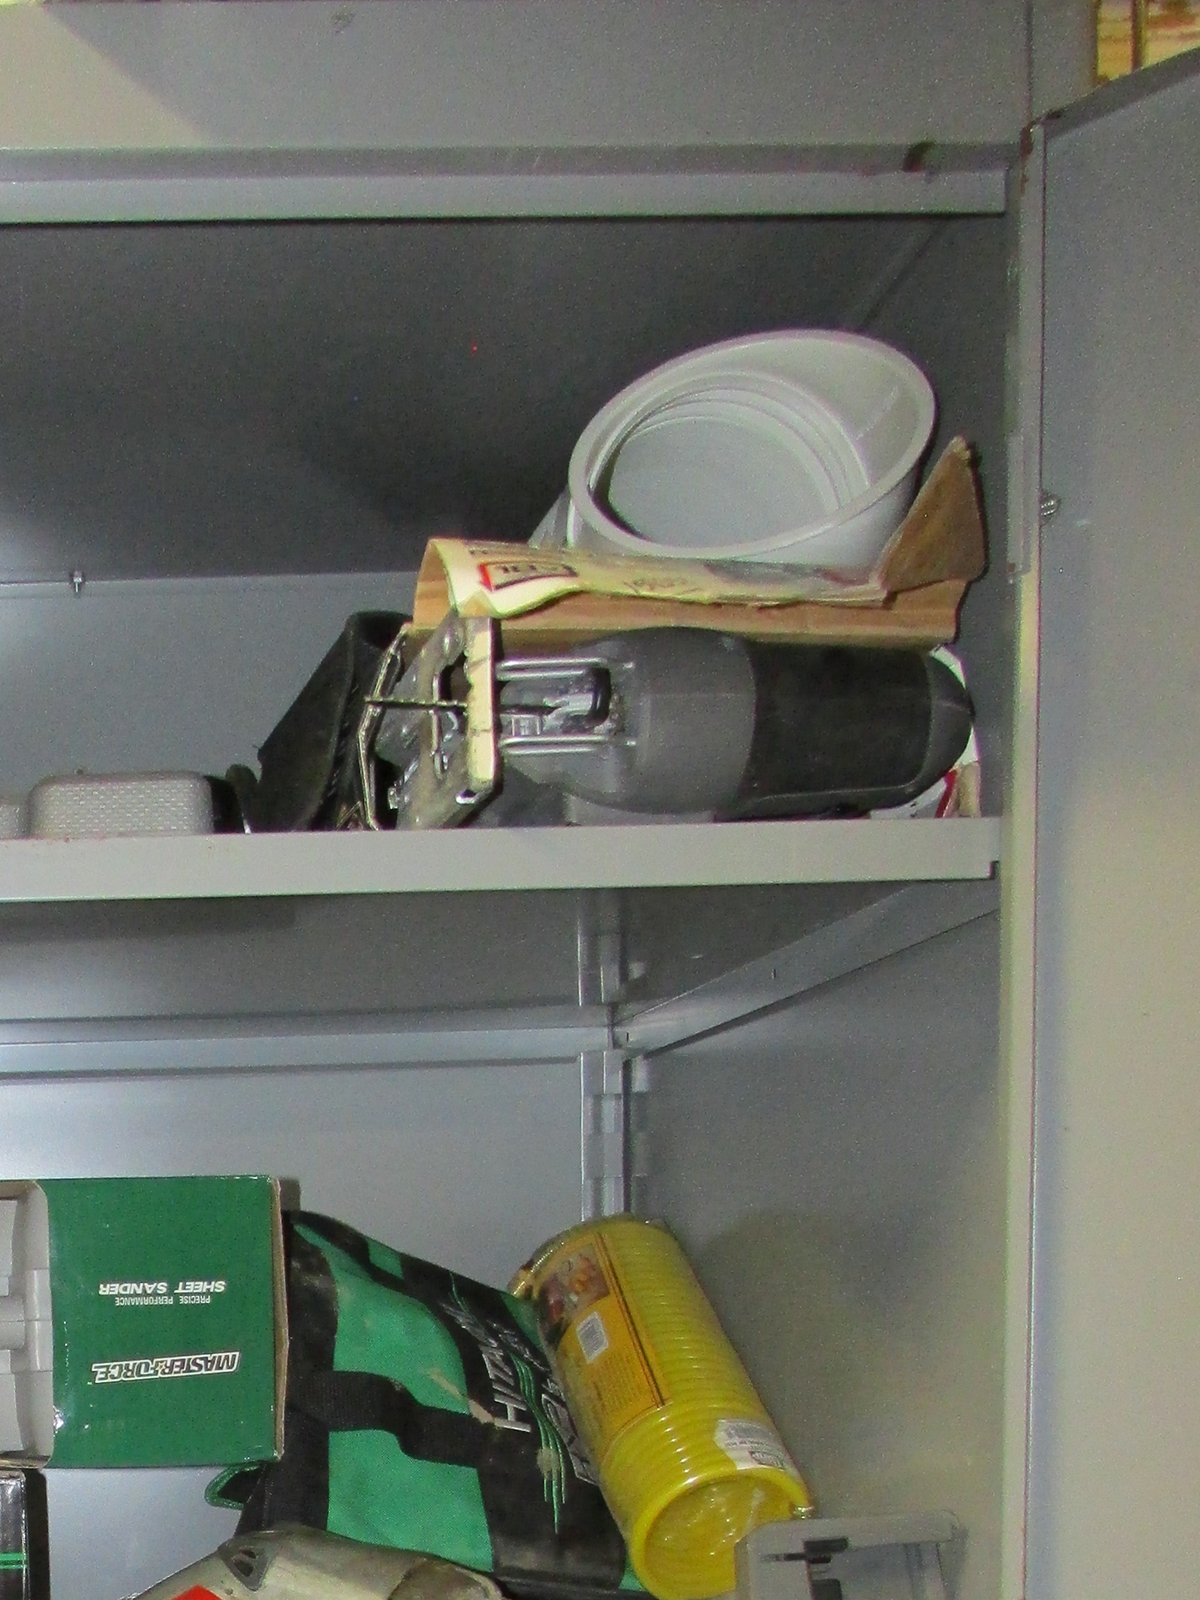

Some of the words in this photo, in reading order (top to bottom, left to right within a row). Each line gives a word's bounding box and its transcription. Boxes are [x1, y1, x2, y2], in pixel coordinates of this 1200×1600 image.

[99, 1282, 167, 1294] SANDER
[174, 1281, 226, 1292] SHEET
[115, 1296, 173, 1305] PERFORMANCE
[179, 1296, 210, 1304] PRECISE
